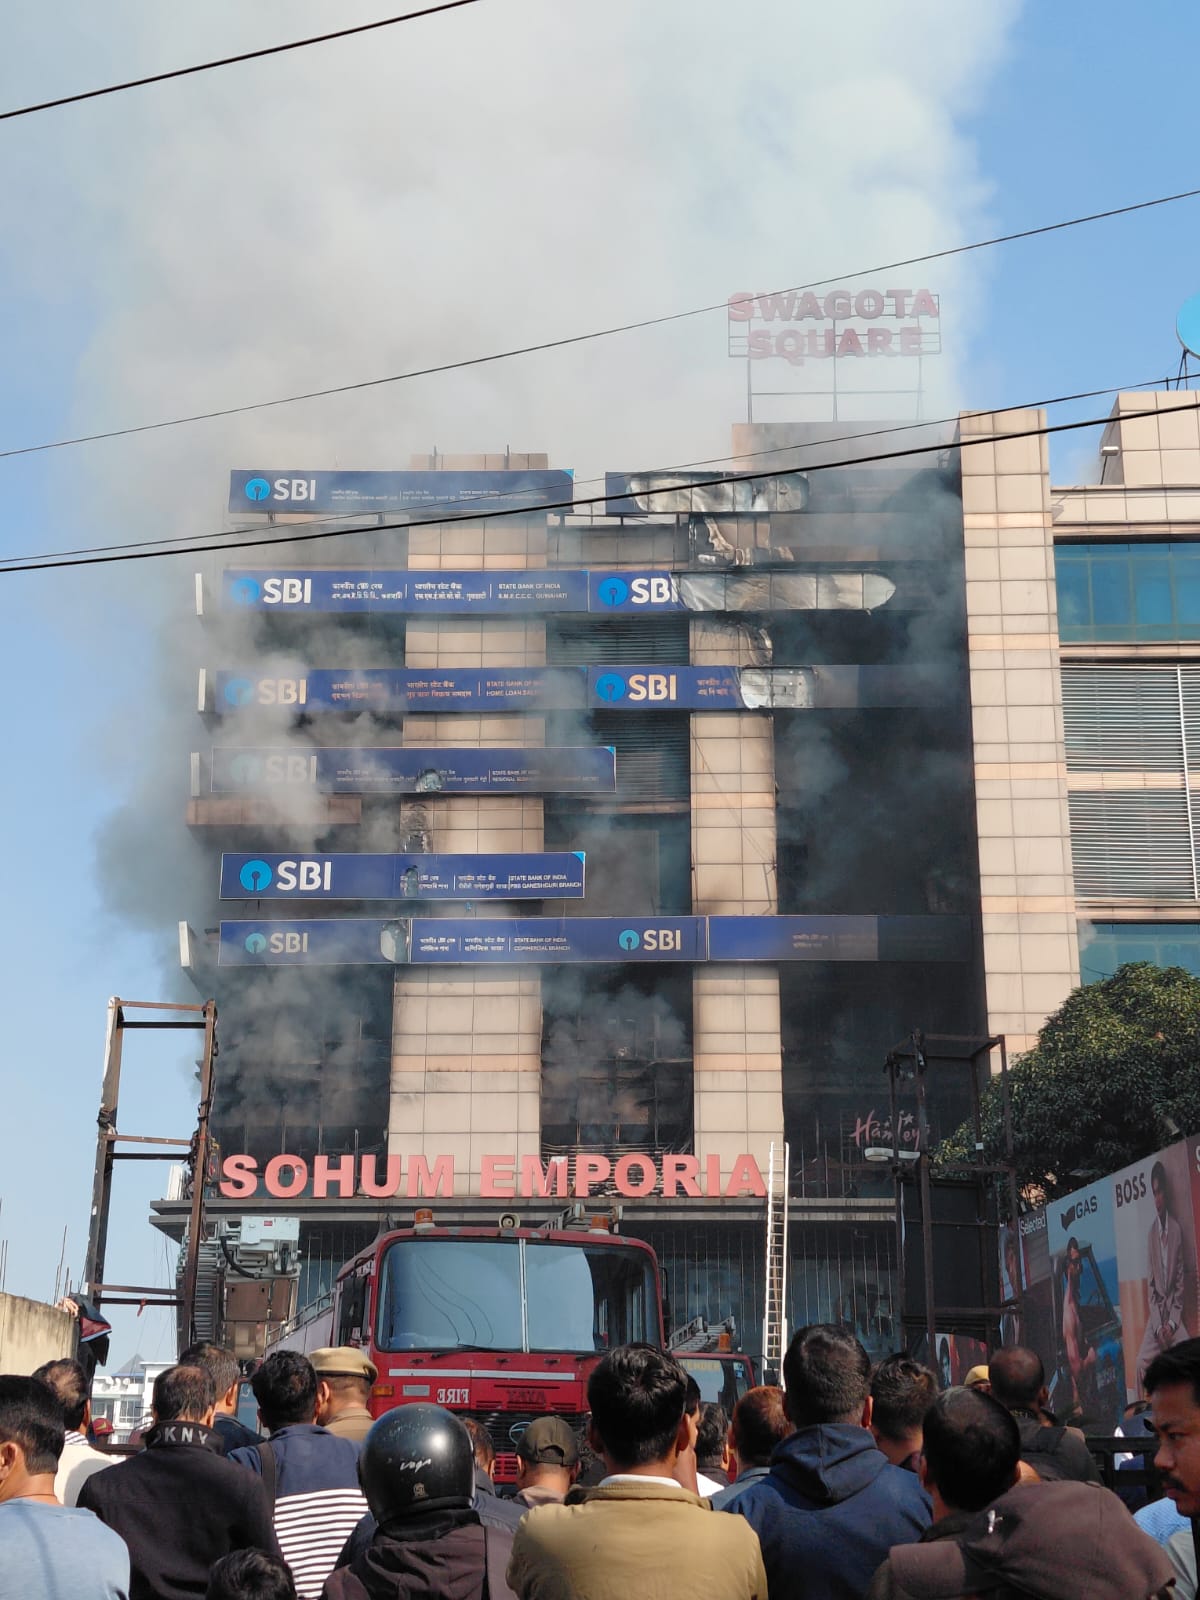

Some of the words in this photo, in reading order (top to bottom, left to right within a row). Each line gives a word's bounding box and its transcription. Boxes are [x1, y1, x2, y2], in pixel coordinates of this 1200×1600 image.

[728, 289, 939, 322] SWAGOTA
[747, 326, 922, 366] SQUARE
[274, 478, 316, 501] SBI
[263, 578, 312, 604] SBI
[631, 578, 679, 604] SBI
[257, 679, 307, 705] SBI
[628, 674, 676, 701] SBI
[266, 755, 317, 784] SBI
[276, 860, 332, 891] SBI
[270, 932, 308, 953] SBI
[643, 929, 681, 951] SBI
[219, 1154, 454, 1198] SOHUM
[480, 1154, 768, 1198] EMPORIA
[1115, 1173, 1147, 1208] BOSS
[1075, 1196, 1098, 1219] GAS
[1020, 1211, 1046, 1236] Selected
